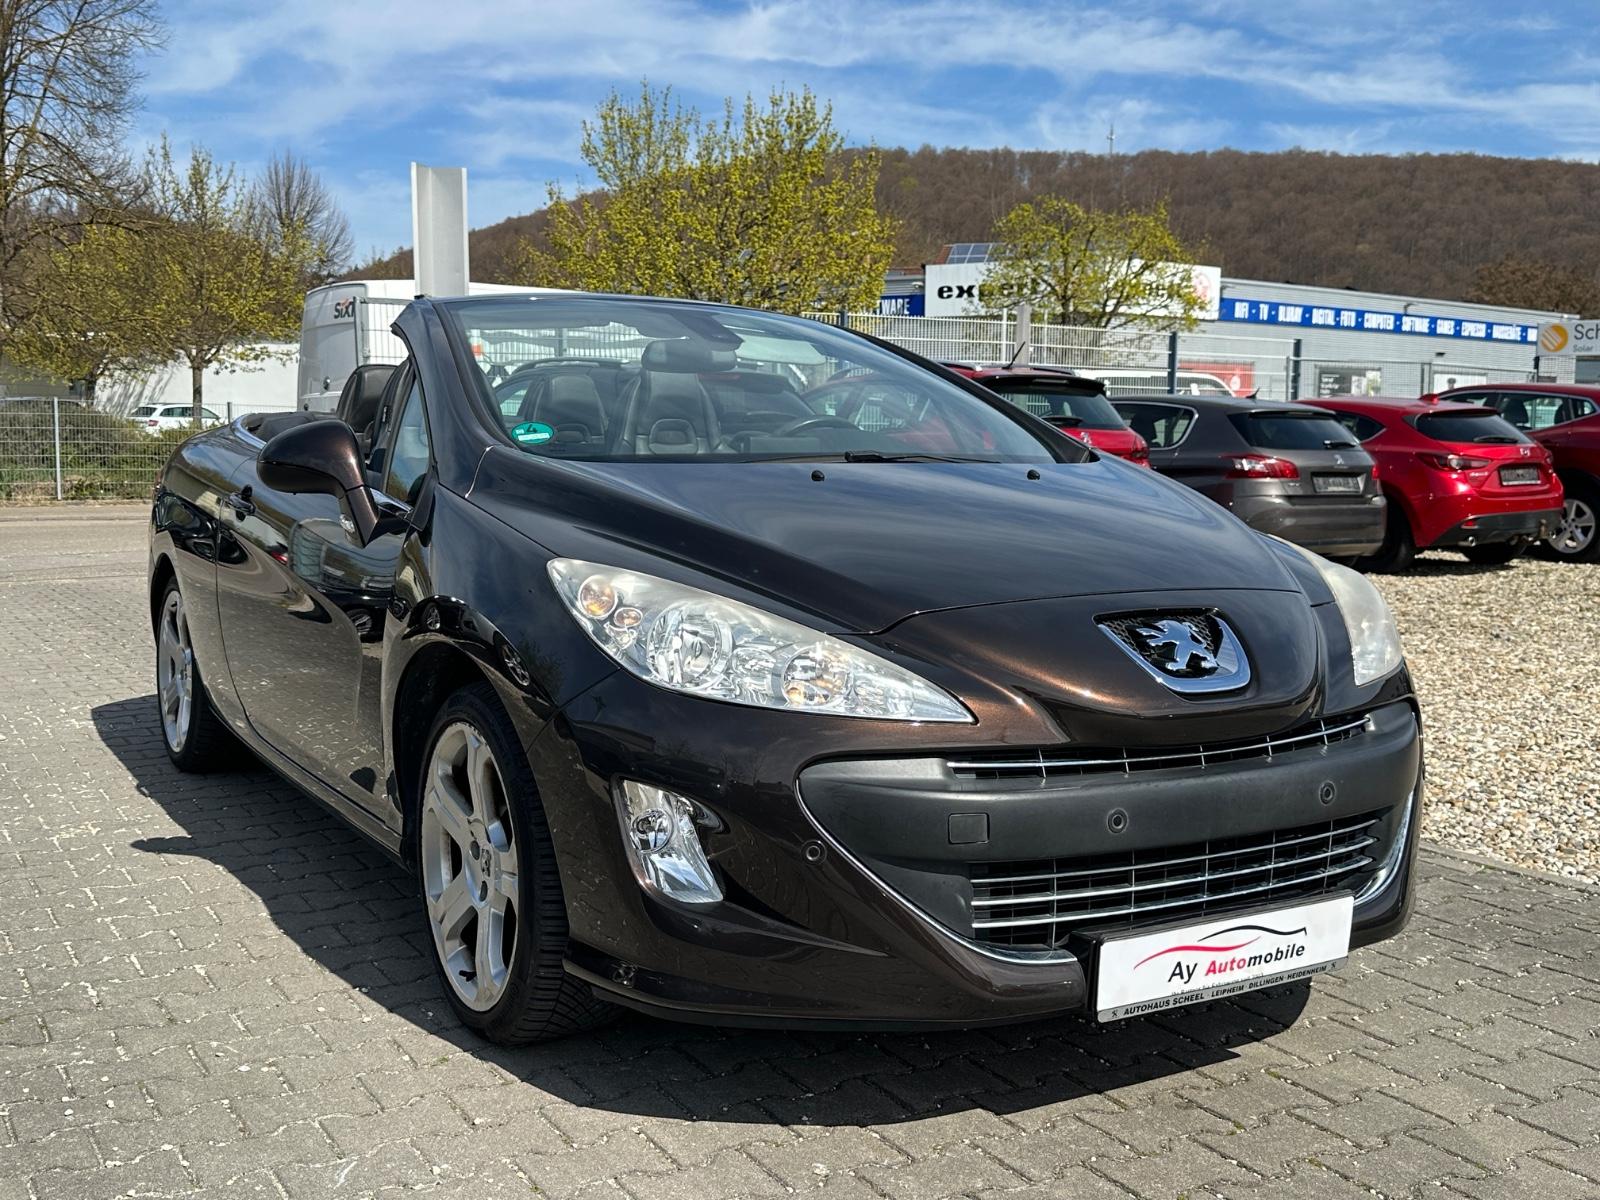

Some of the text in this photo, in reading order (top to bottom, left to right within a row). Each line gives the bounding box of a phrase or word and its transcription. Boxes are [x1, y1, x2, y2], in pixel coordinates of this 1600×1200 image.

[1259, 303, 1269, 321] TV
[1364, 313, 1394, 331] COMPUTER
[1573, 344, 1594, 353] Solar
[526, 423, 538, 433] 4
[1167, 961, 1198, 985] Ay
[1205, 943, 1305, 977] Automobile
[1123, 999, 1171, 1016] AUTOHAUS
[1172, 992, 1205, 1007] SCHEEL
[1211, 983, 1245, 999] LEIPHEIM
[1248, 975, 1285, 990] DILLINGEN
[1287, 965, 1328, 981] HEIDENHEIM
